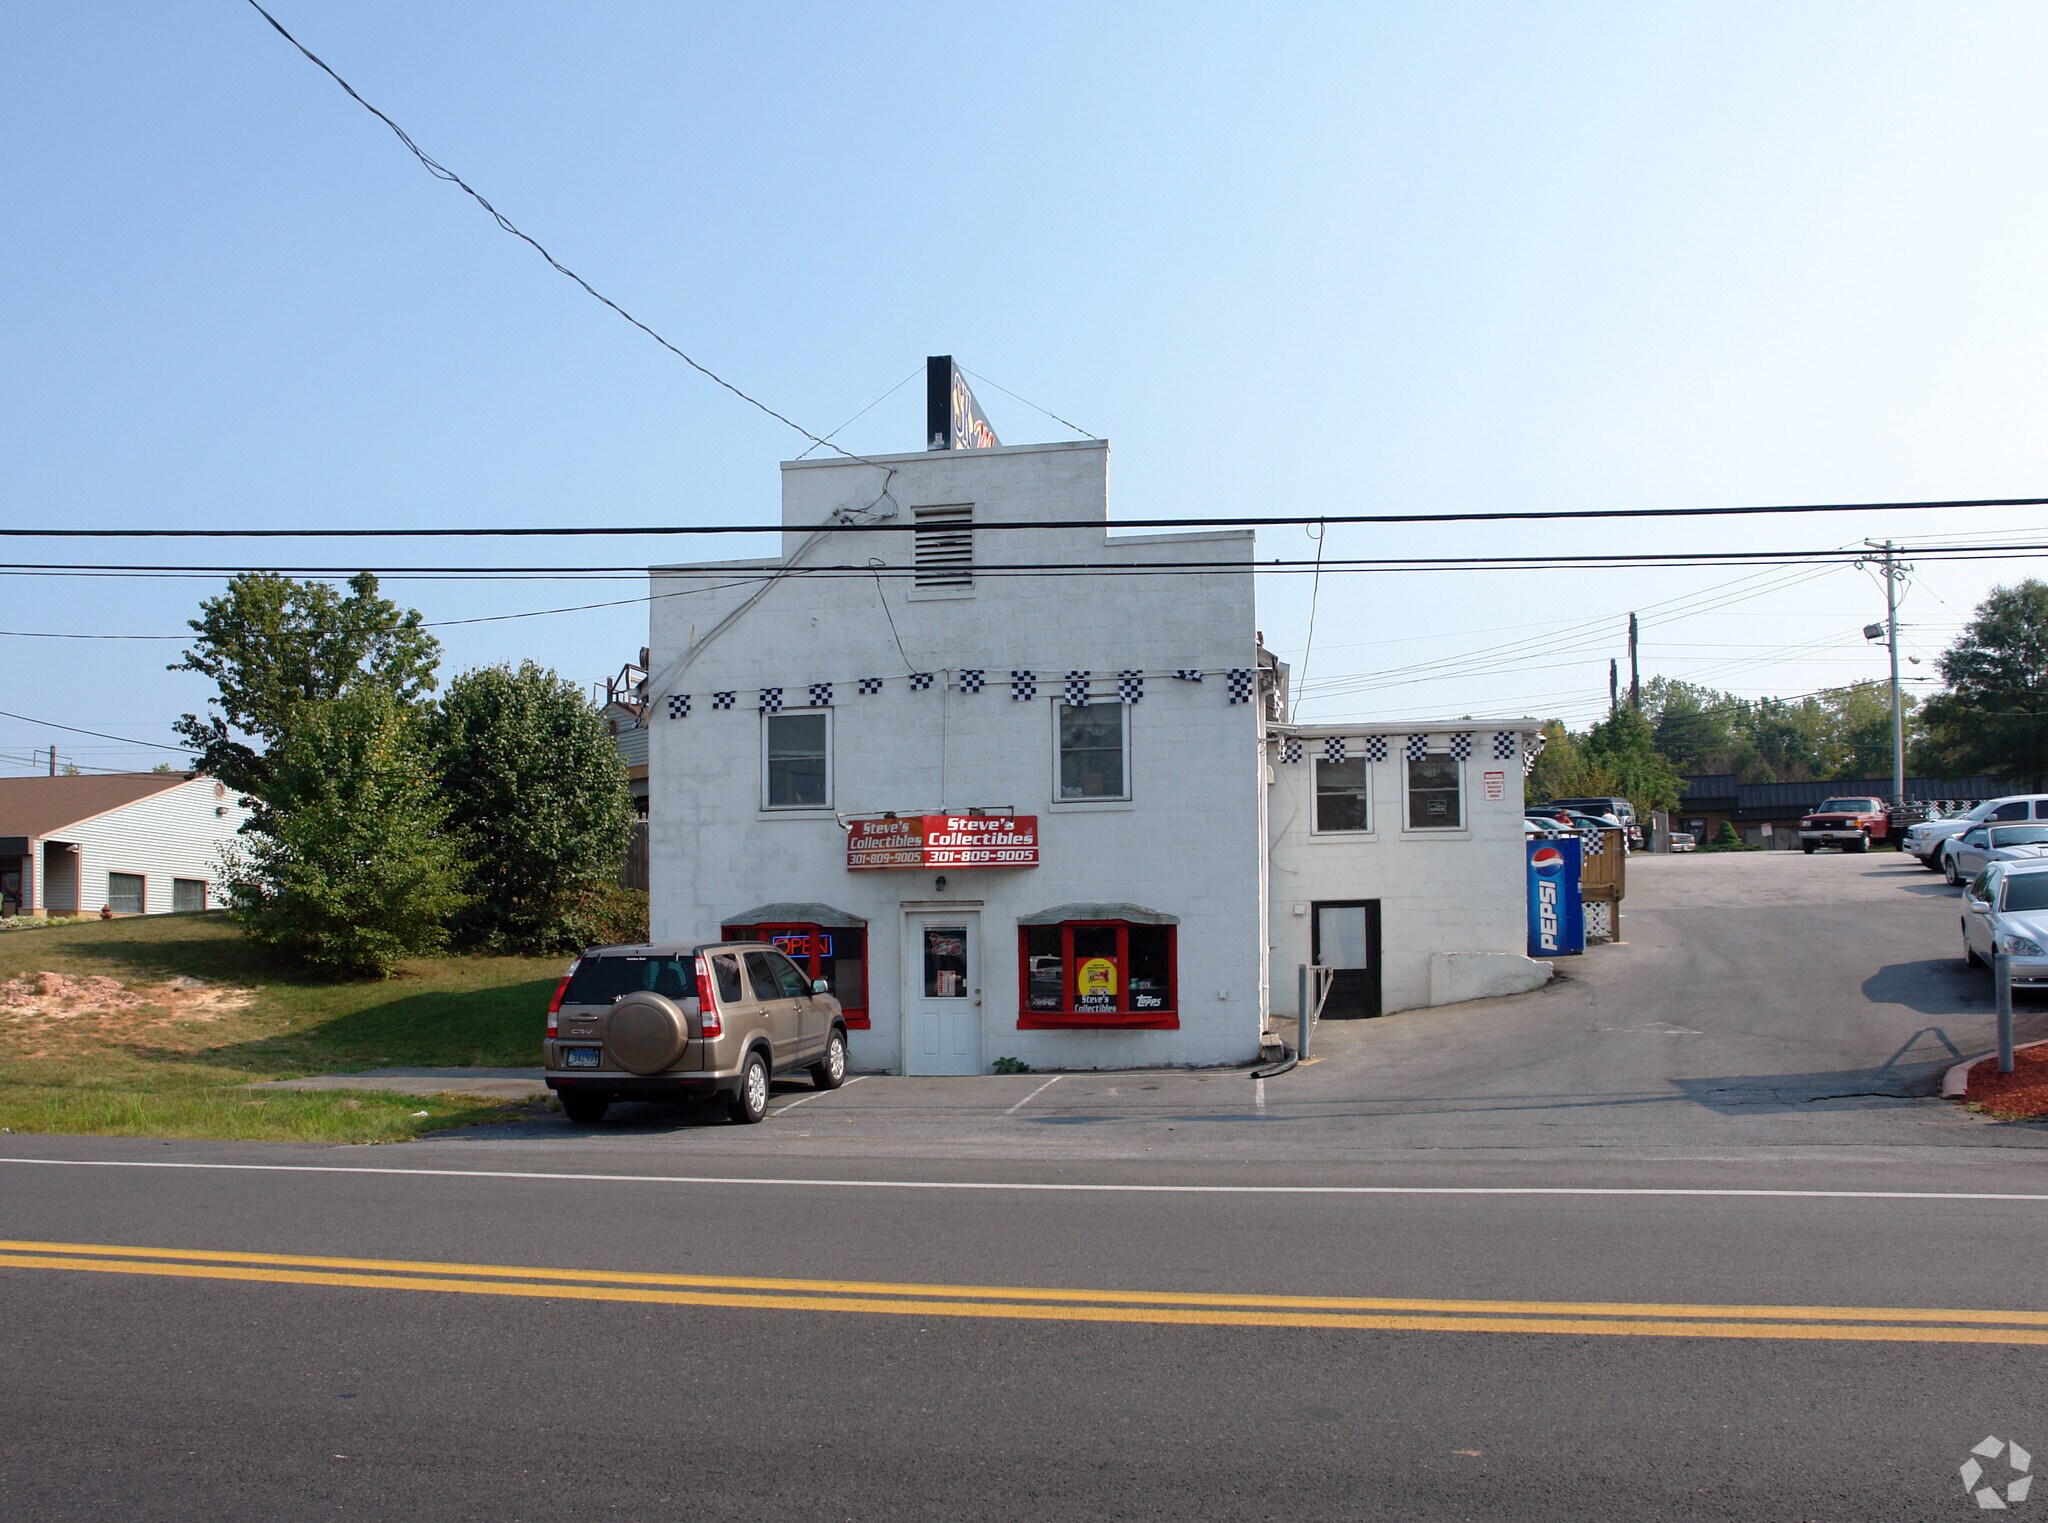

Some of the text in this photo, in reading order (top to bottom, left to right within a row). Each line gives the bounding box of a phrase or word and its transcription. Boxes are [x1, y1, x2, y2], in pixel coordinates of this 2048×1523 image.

[863, 819, 910, 835] Steve's
[946, 817, 1015, 831] Steve's
[850, 834, 922, 850] Collectibles
[928, 832, 1034, 846] Collectibles
[850, 851, 922, 865] 301-809-9005
[929, 850, 1034, 863] 301-809-9005
[1539, 880, 1558, 951] PEPSI
[774, 937, 829, 955] OPEN
[1081, 994, 1110, 1004] Steve's
[1074, 1004, 1117, 1013] Collectibles
